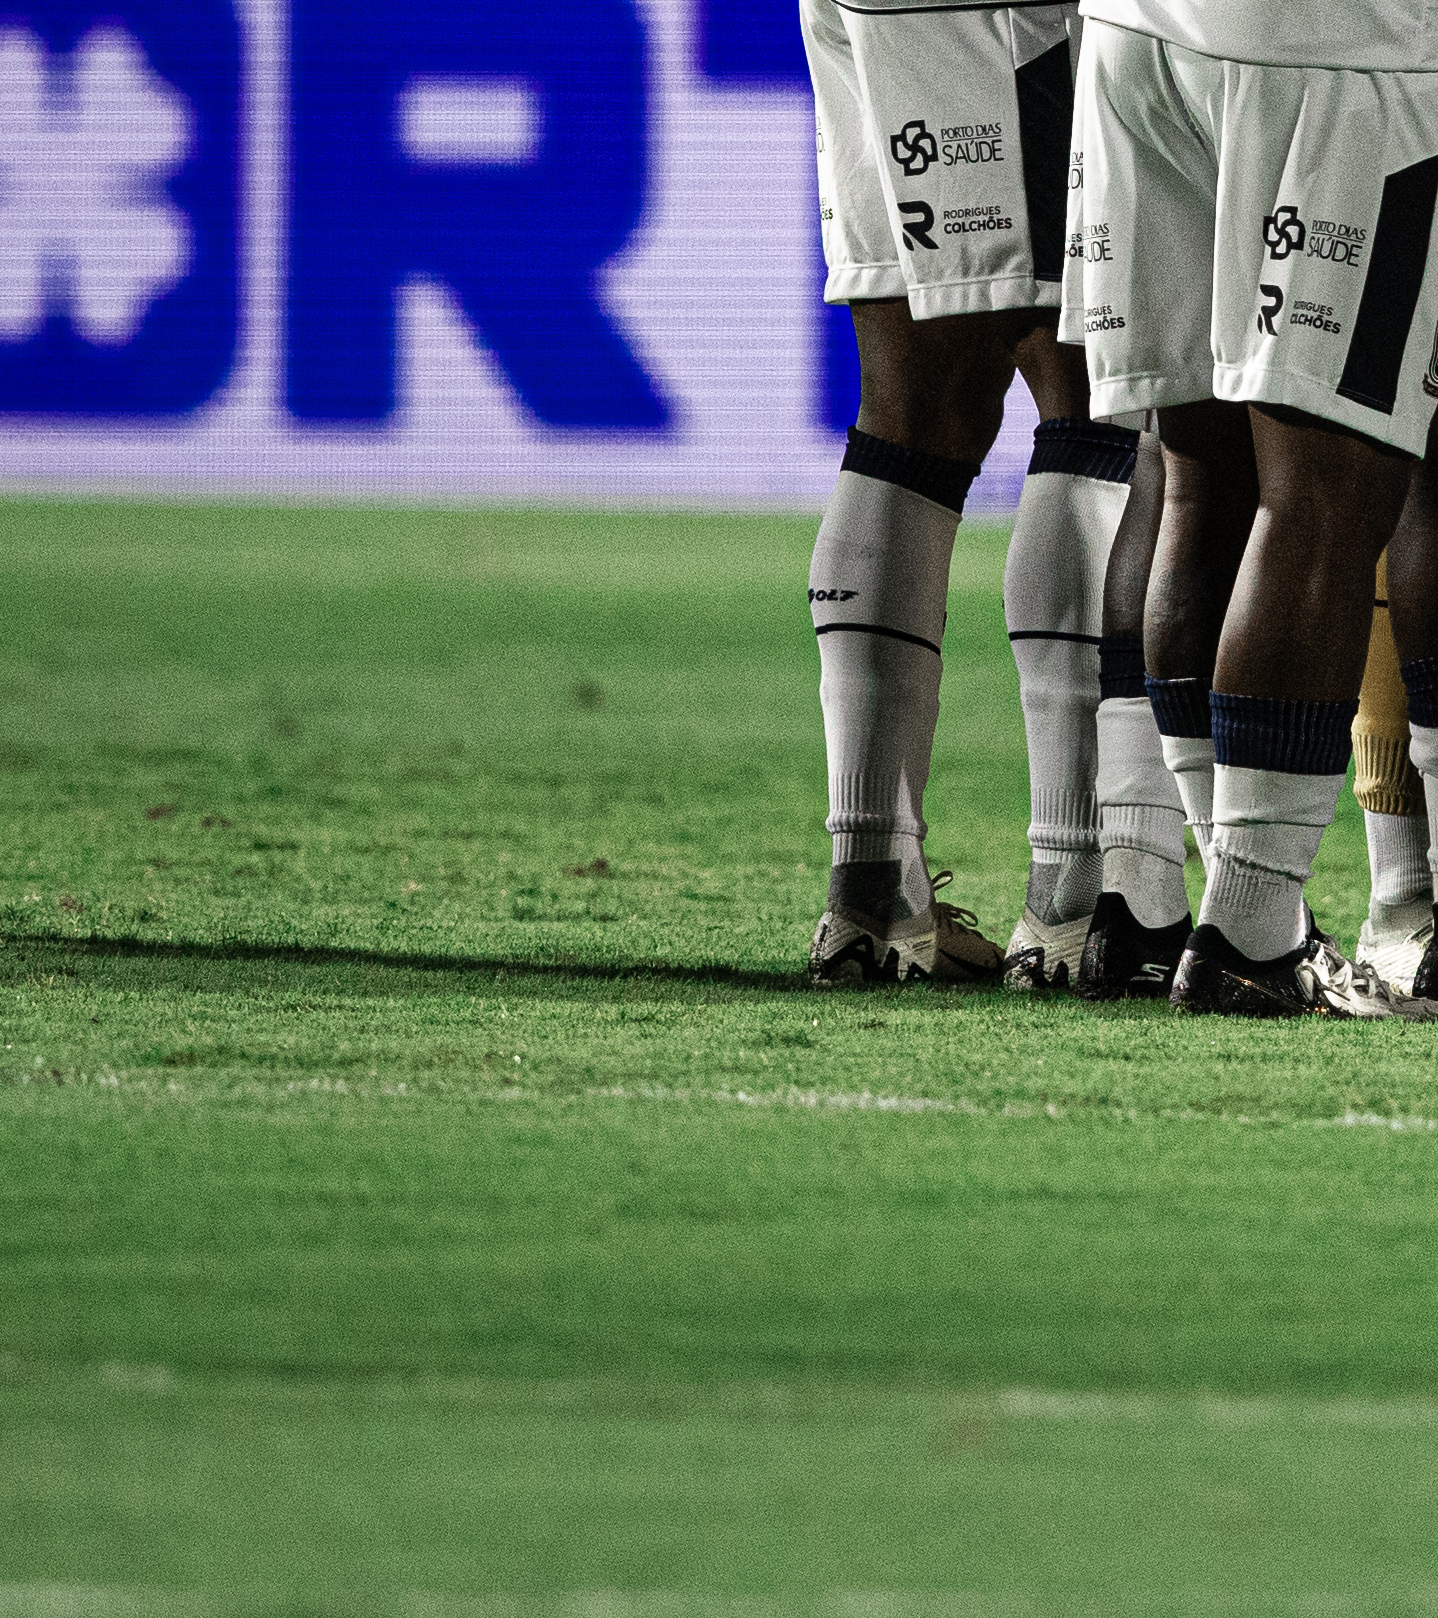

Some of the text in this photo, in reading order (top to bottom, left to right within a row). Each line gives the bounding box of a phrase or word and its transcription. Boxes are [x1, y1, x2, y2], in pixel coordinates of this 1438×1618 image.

[941, 122, 1002, 140] PORTO DIAS
[942, 139, 1004, 166] SAÚDE
[943, 205, 1001, 220] RODRIGUES
[943, 217, 1013, 235] COLCHÕES
[1337, 224, 1367, 240] DIAS
[1307, 235, 1363, 267] SAÚDE
